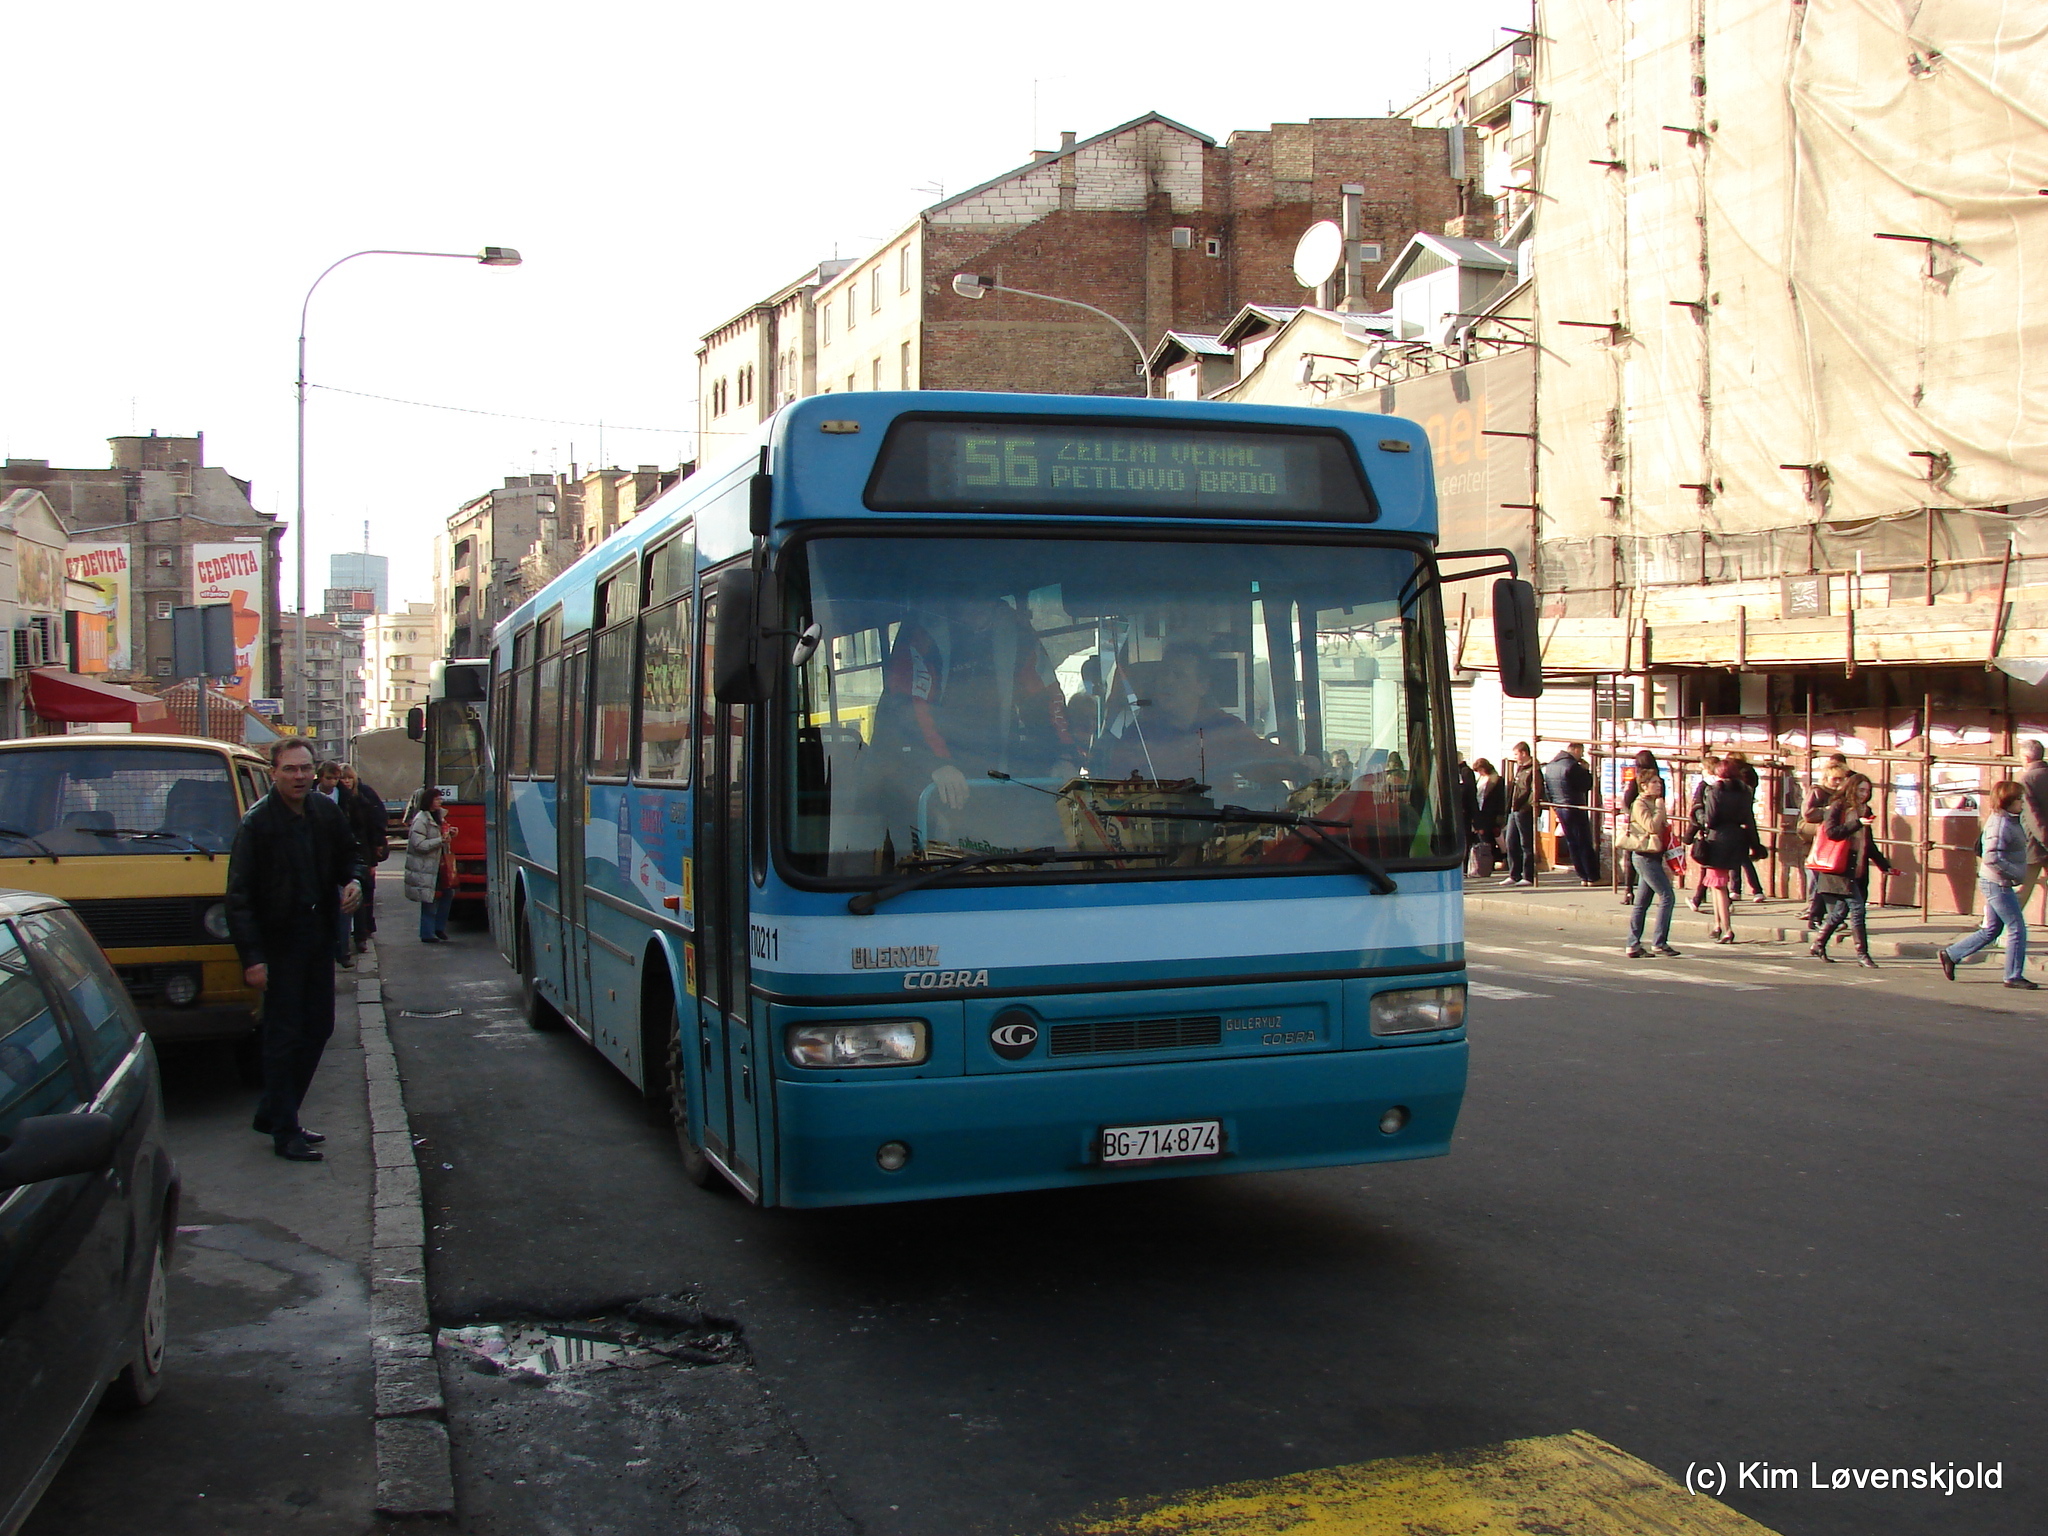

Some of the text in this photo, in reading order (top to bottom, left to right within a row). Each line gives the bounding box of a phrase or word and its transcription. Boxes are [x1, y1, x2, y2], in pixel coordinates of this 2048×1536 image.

[965, 435, 1038, 487] 56
[1052, 466, 1277, 495] PETLOVO BRDO
[197, 550, 258, 583] CEDEVITA
[852, 945, 939, 969] ULERYUZ
[903, 970, 988, 990] COBRA
[1226, 1016, 1282, 1031] GULERYUZ
[1262, 1030, 1316, 1046] COBRA
